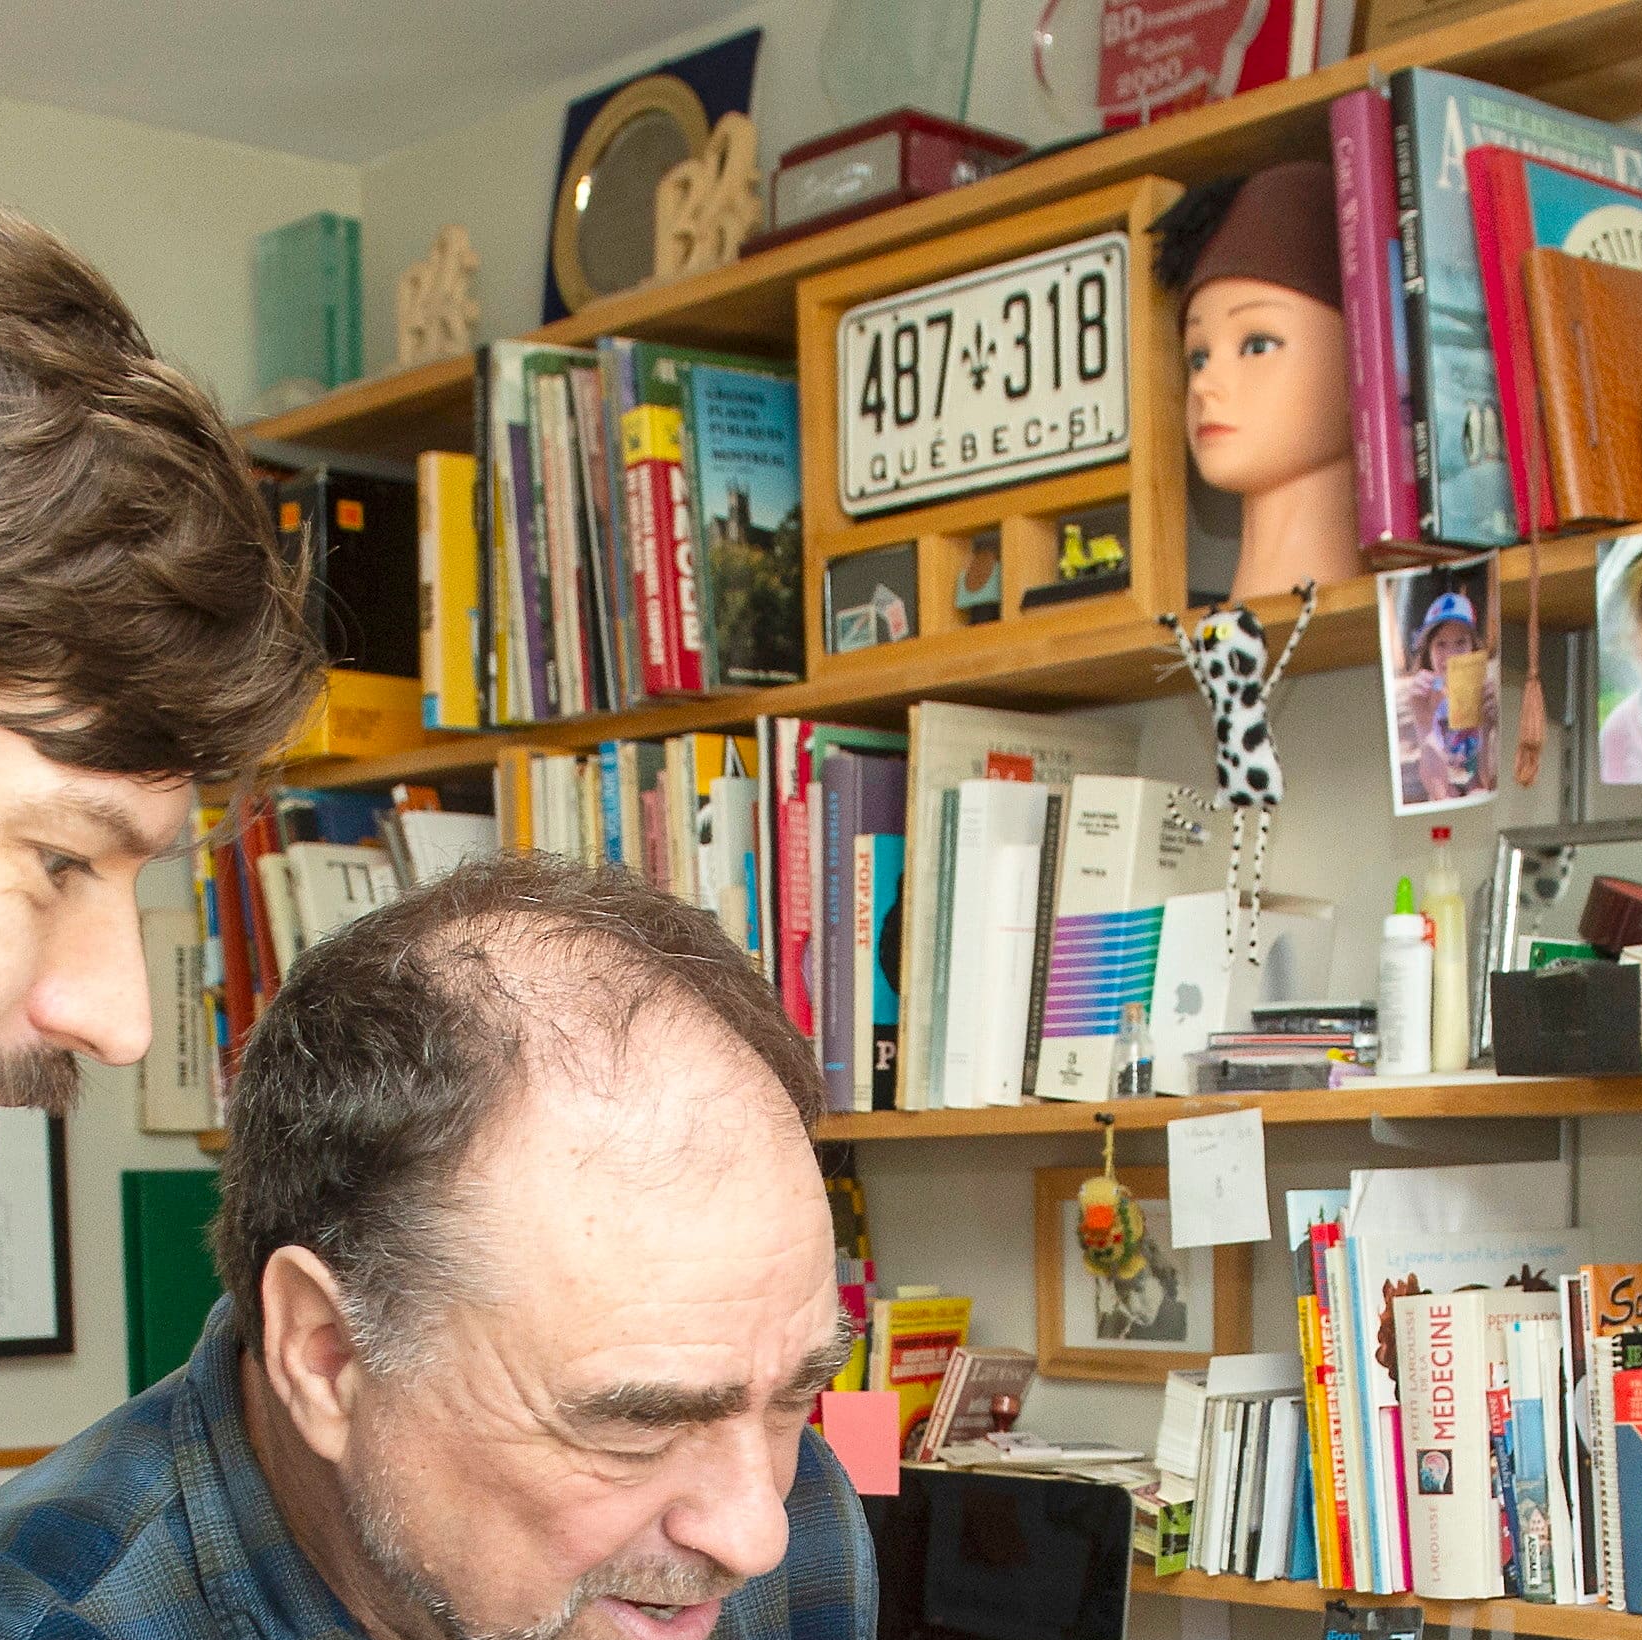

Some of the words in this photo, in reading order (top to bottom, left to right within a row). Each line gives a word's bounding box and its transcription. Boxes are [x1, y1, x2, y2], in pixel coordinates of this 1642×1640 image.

[860, 308, 954, 436] 487
[1002, 269, 1108, 400] 318
[858, 893, 873, 950] ART
[1404, 1309, 1418, 1395] LAROUSSE
[1425, 1303, 1456, 1441] MÉDECINE
[1409, 1399, 1420, 1442] PETIT
[1427, 1504, 1442, 1583] LAROUSSE
